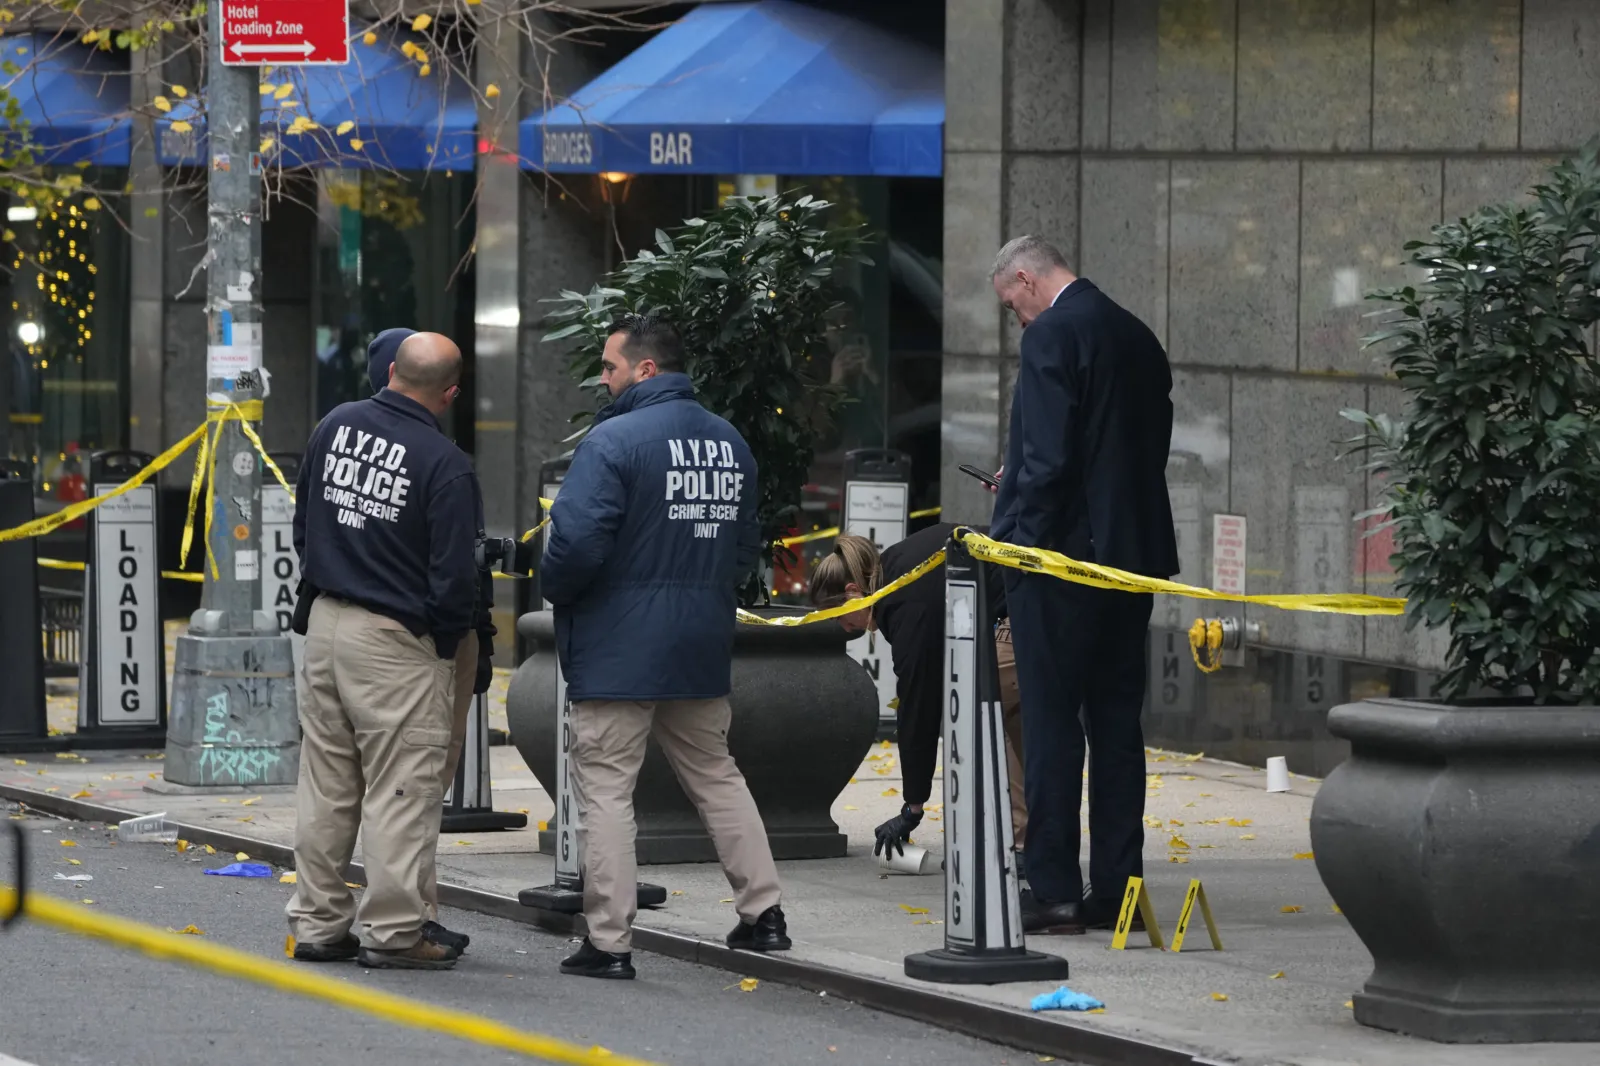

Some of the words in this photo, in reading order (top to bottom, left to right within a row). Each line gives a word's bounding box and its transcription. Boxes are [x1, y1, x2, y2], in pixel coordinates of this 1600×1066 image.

[228, 5, 258, 18] Hotel
[228, 21, 272, 37] Loading
[276, 20, 303, 34] Zone
[543, 132, 592, 164] BRIDGES
[650, 132, 692, 165] BAR
[331, 425, 407, 475] N.Y.P.D.
[668, 439, 740, 469] N.Y.P.D.
[322, 453, 411, 507] POLICE
[665, 470, 744, 502] POLICE
[337, 508, 366, 530] UNIT
[668, 504, 707, 520] CRIME
[694, 523, 720, 538] UNIT
[118, 529, 140, 713] LOADING
[950, 647, 961, 926] LOADING
[1119, 886, 1134, 933] 3
[1179, 887, 1195, 933] 2
